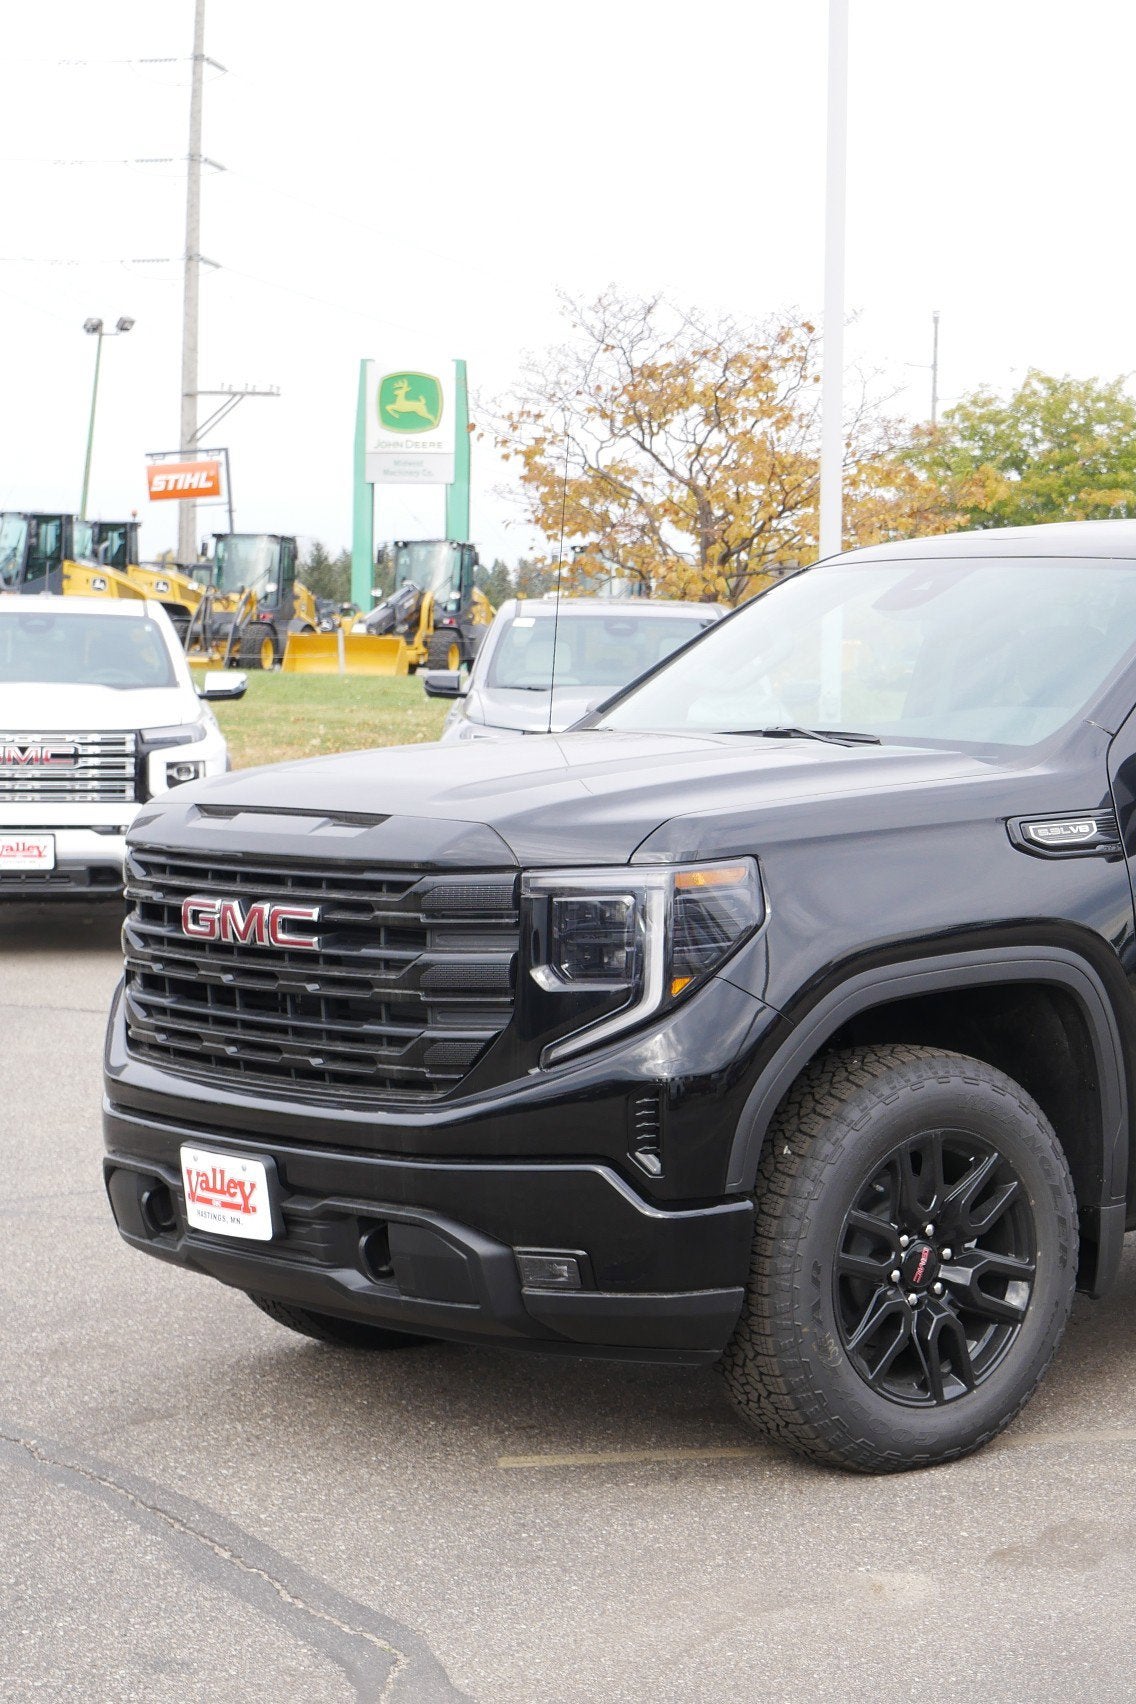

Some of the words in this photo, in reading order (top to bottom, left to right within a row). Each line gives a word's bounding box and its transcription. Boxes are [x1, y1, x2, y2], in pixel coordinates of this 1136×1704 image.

[374, 439, 403, 449] JOHN
[405, 439, 444, 449] DEERE
[150, 471, 214, 492] STIHL
[0, 746, 75, 765] MC
[181, 896, 321, 951] GMC
